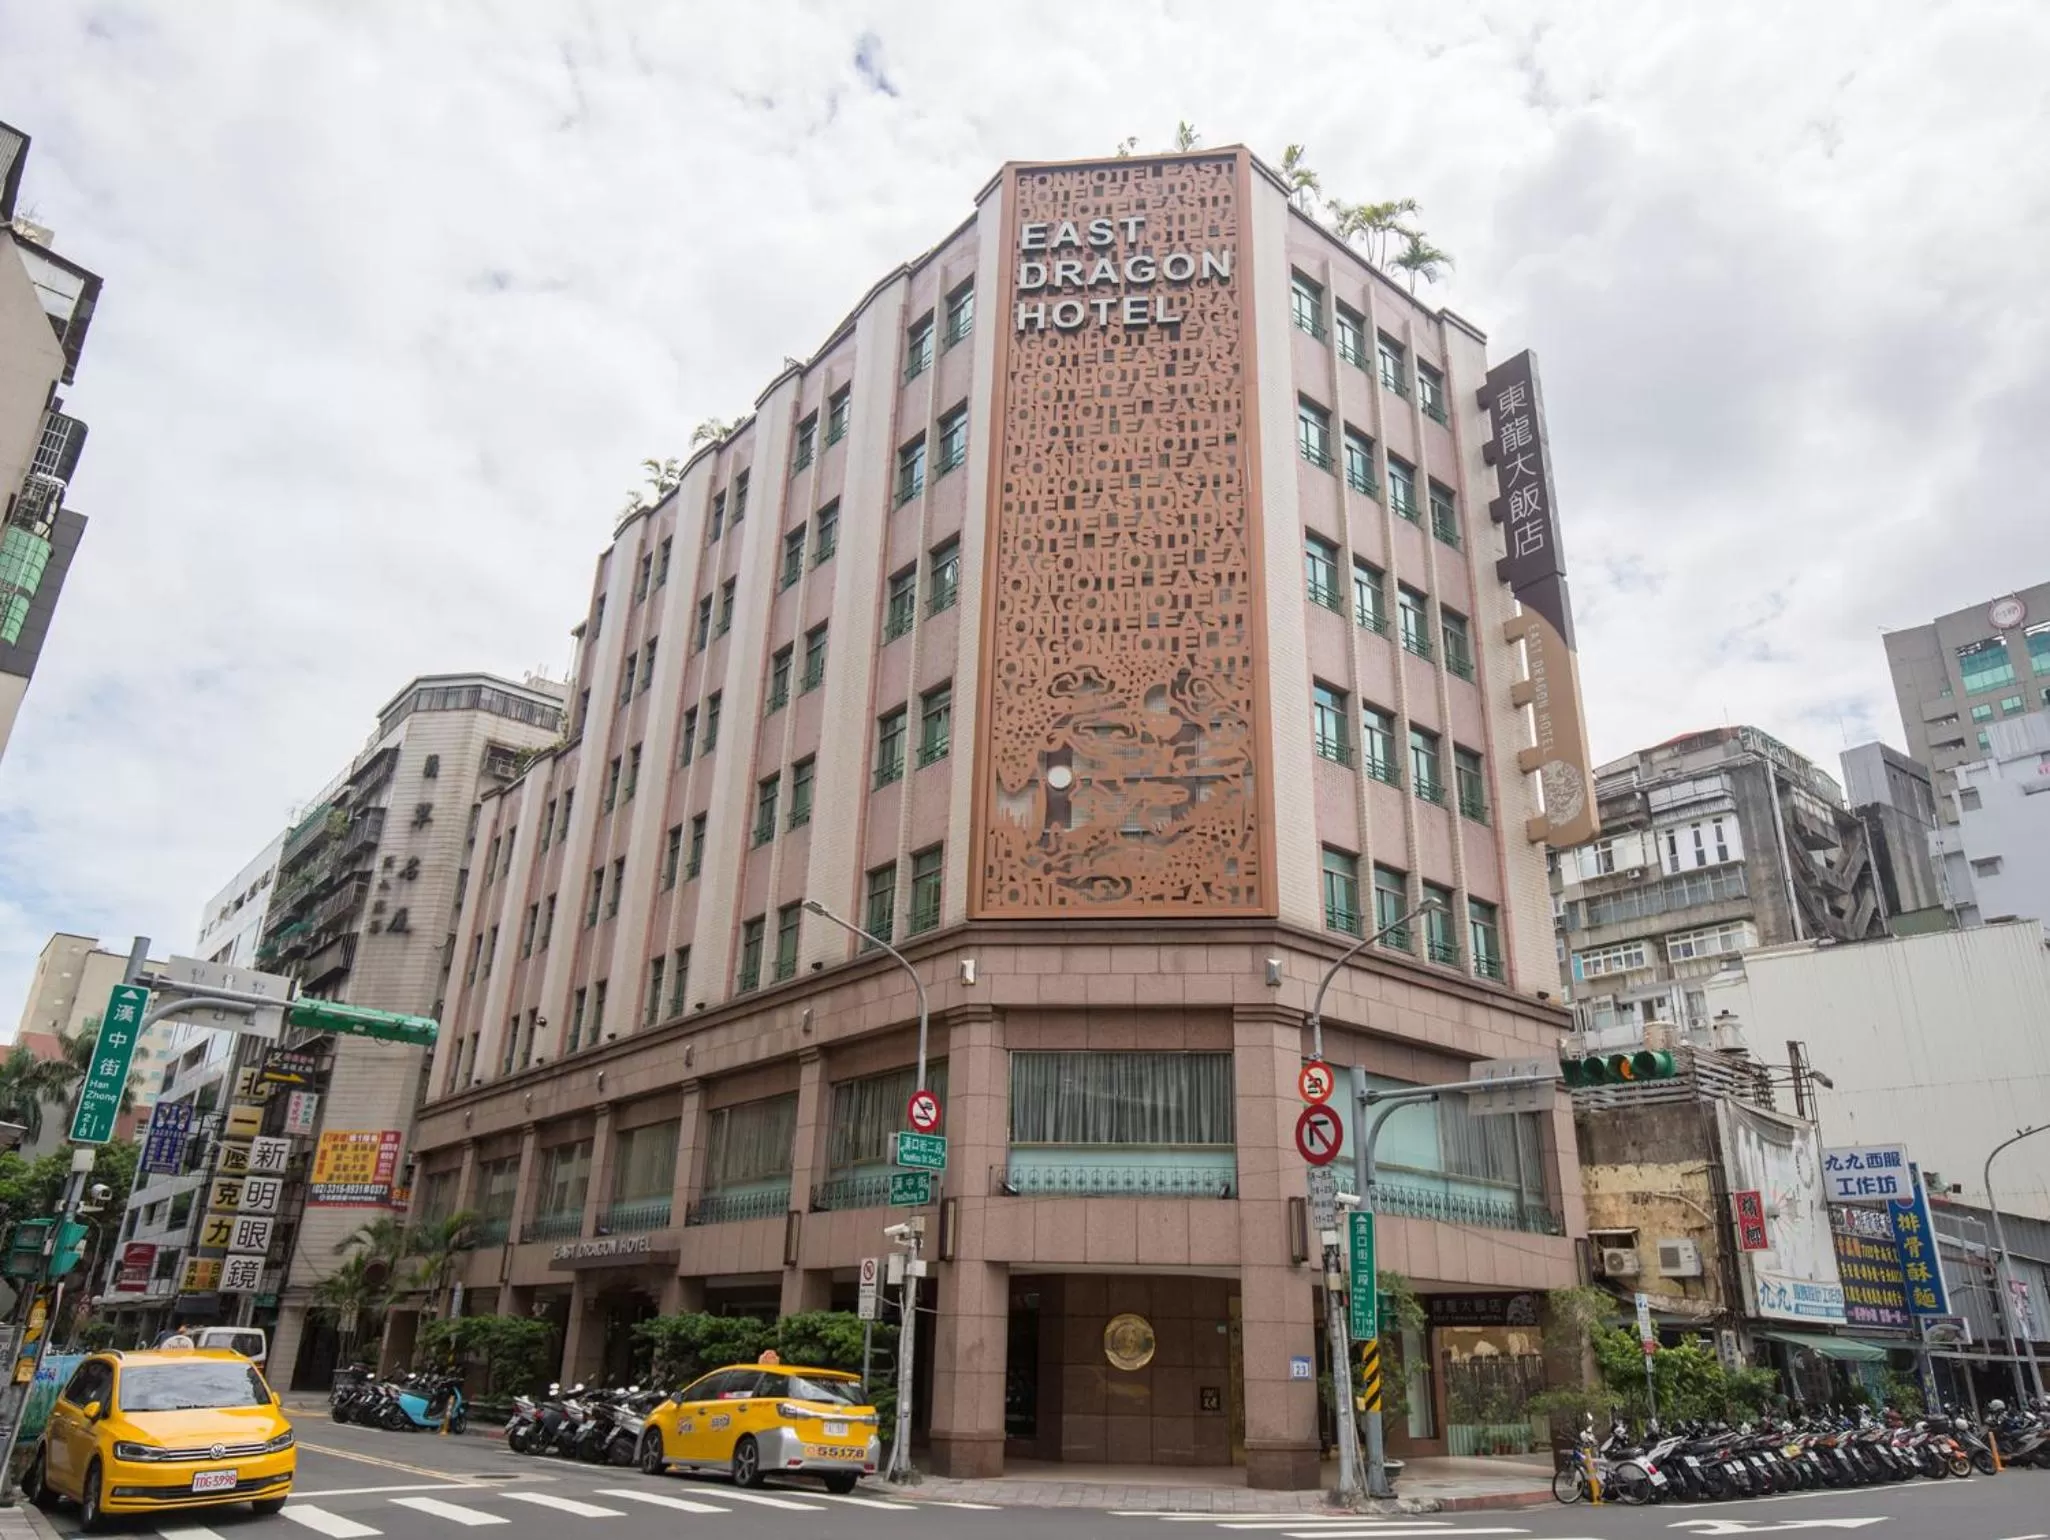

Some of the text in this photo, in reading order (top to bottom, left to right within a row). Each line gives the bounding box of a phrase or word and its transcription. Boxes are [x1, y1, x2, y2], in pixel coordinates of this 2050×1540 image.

[1021, 216, 1146, 250] EAST
[1019, 250, 1230, 290] DRAGON
[1018, 295, 1181, 331] HOTEL
[1497, 380, 1544, 560] 東龍大飯店
[1532, 660, 1550, 711] DRAGON
[99, 1003, 136, 1077] 漢中街
[86, 1090, 117, 1104] Zhong
[89, 1079, 109, 1090] Han
[1825, 1151, 1901, 1171] 九九西服
[1836, 1175, 1897, 1196] 工作坊
[226, 1141, 285, 1289] 新明眼鏡
[619, 1236, 651, 1254] HOTEL
[1897, 1212, 1938, 1309] 排骨酥麵
